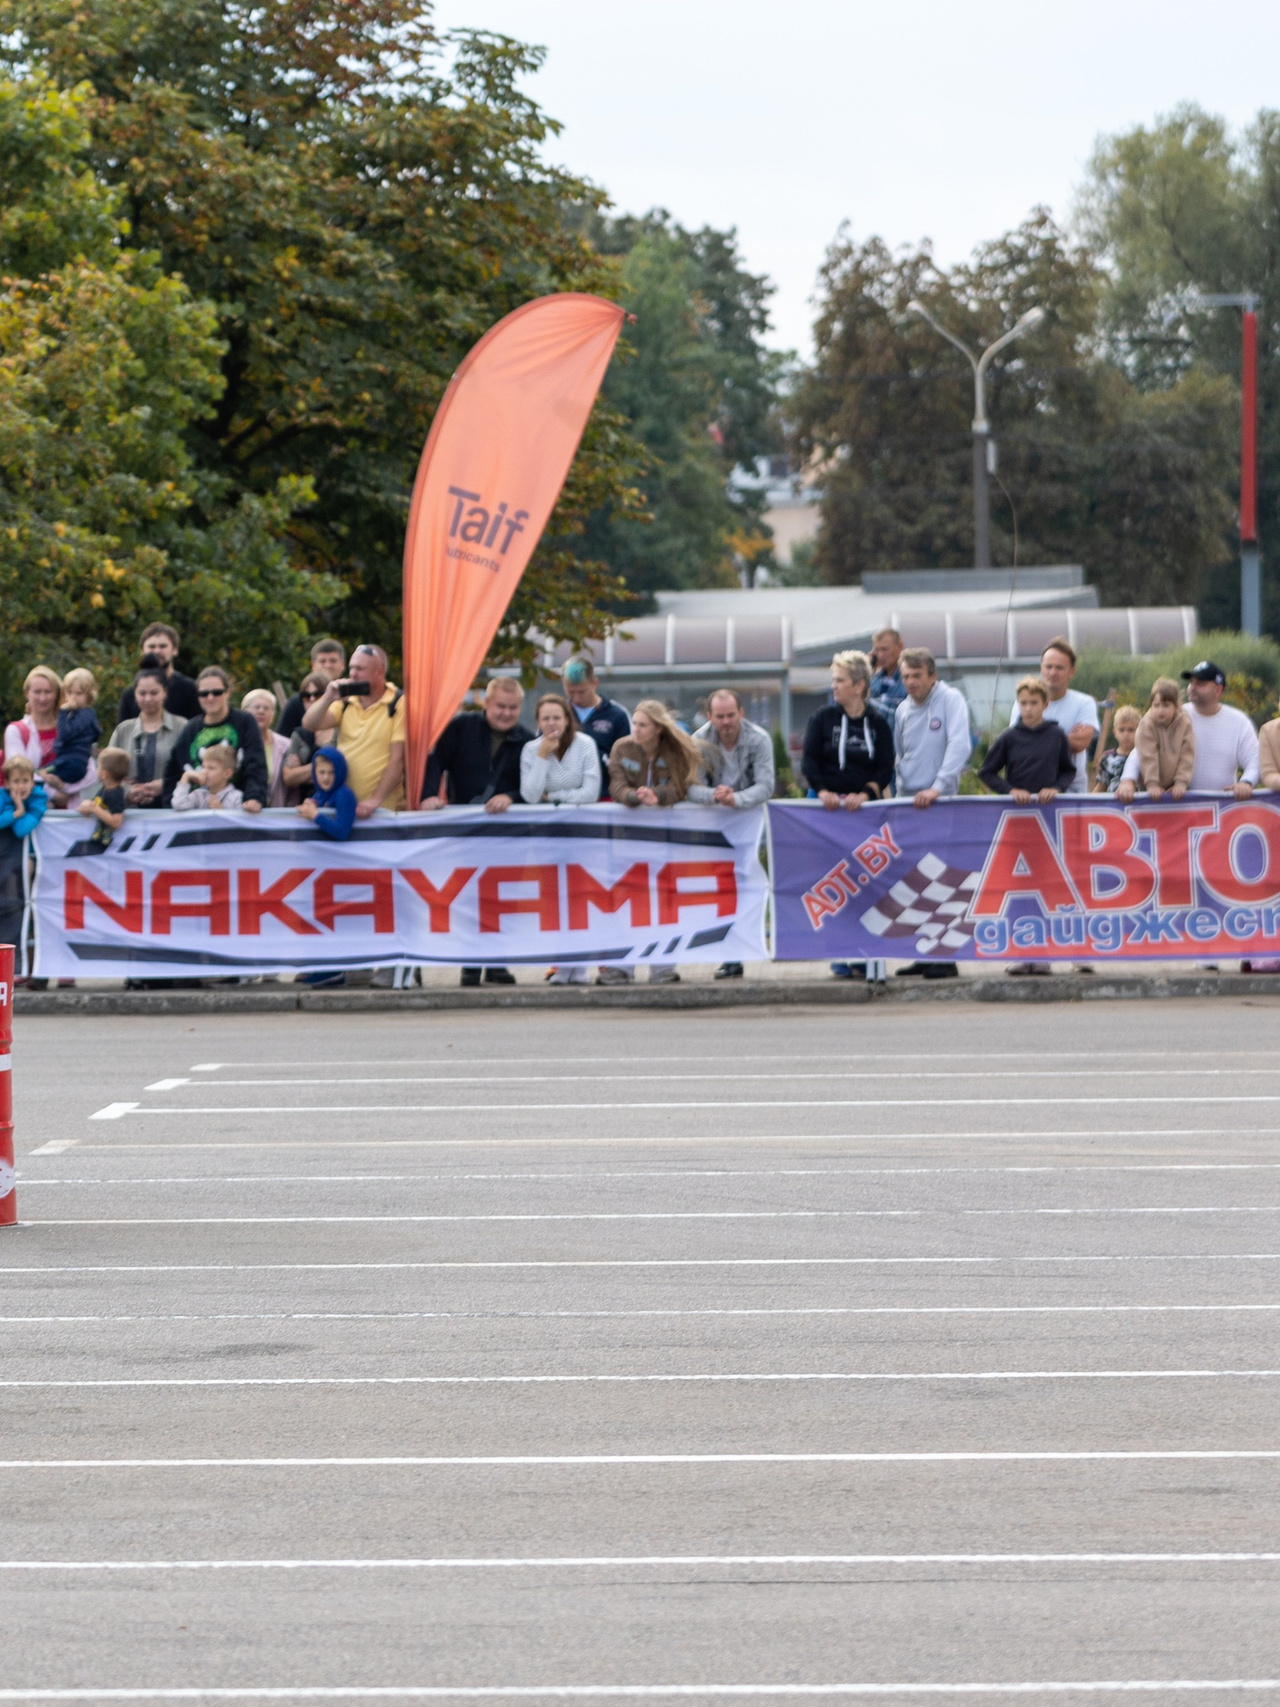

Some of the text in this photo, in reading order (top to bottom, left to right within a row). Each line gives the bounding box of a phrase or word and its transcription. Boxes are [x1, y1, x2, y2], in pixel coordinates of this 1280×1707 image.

[447, 485, 531, 556] Taif
[63, 859, 739, 936] NAKAYAMA
[801, 822, 903, 932] ADT.BY
